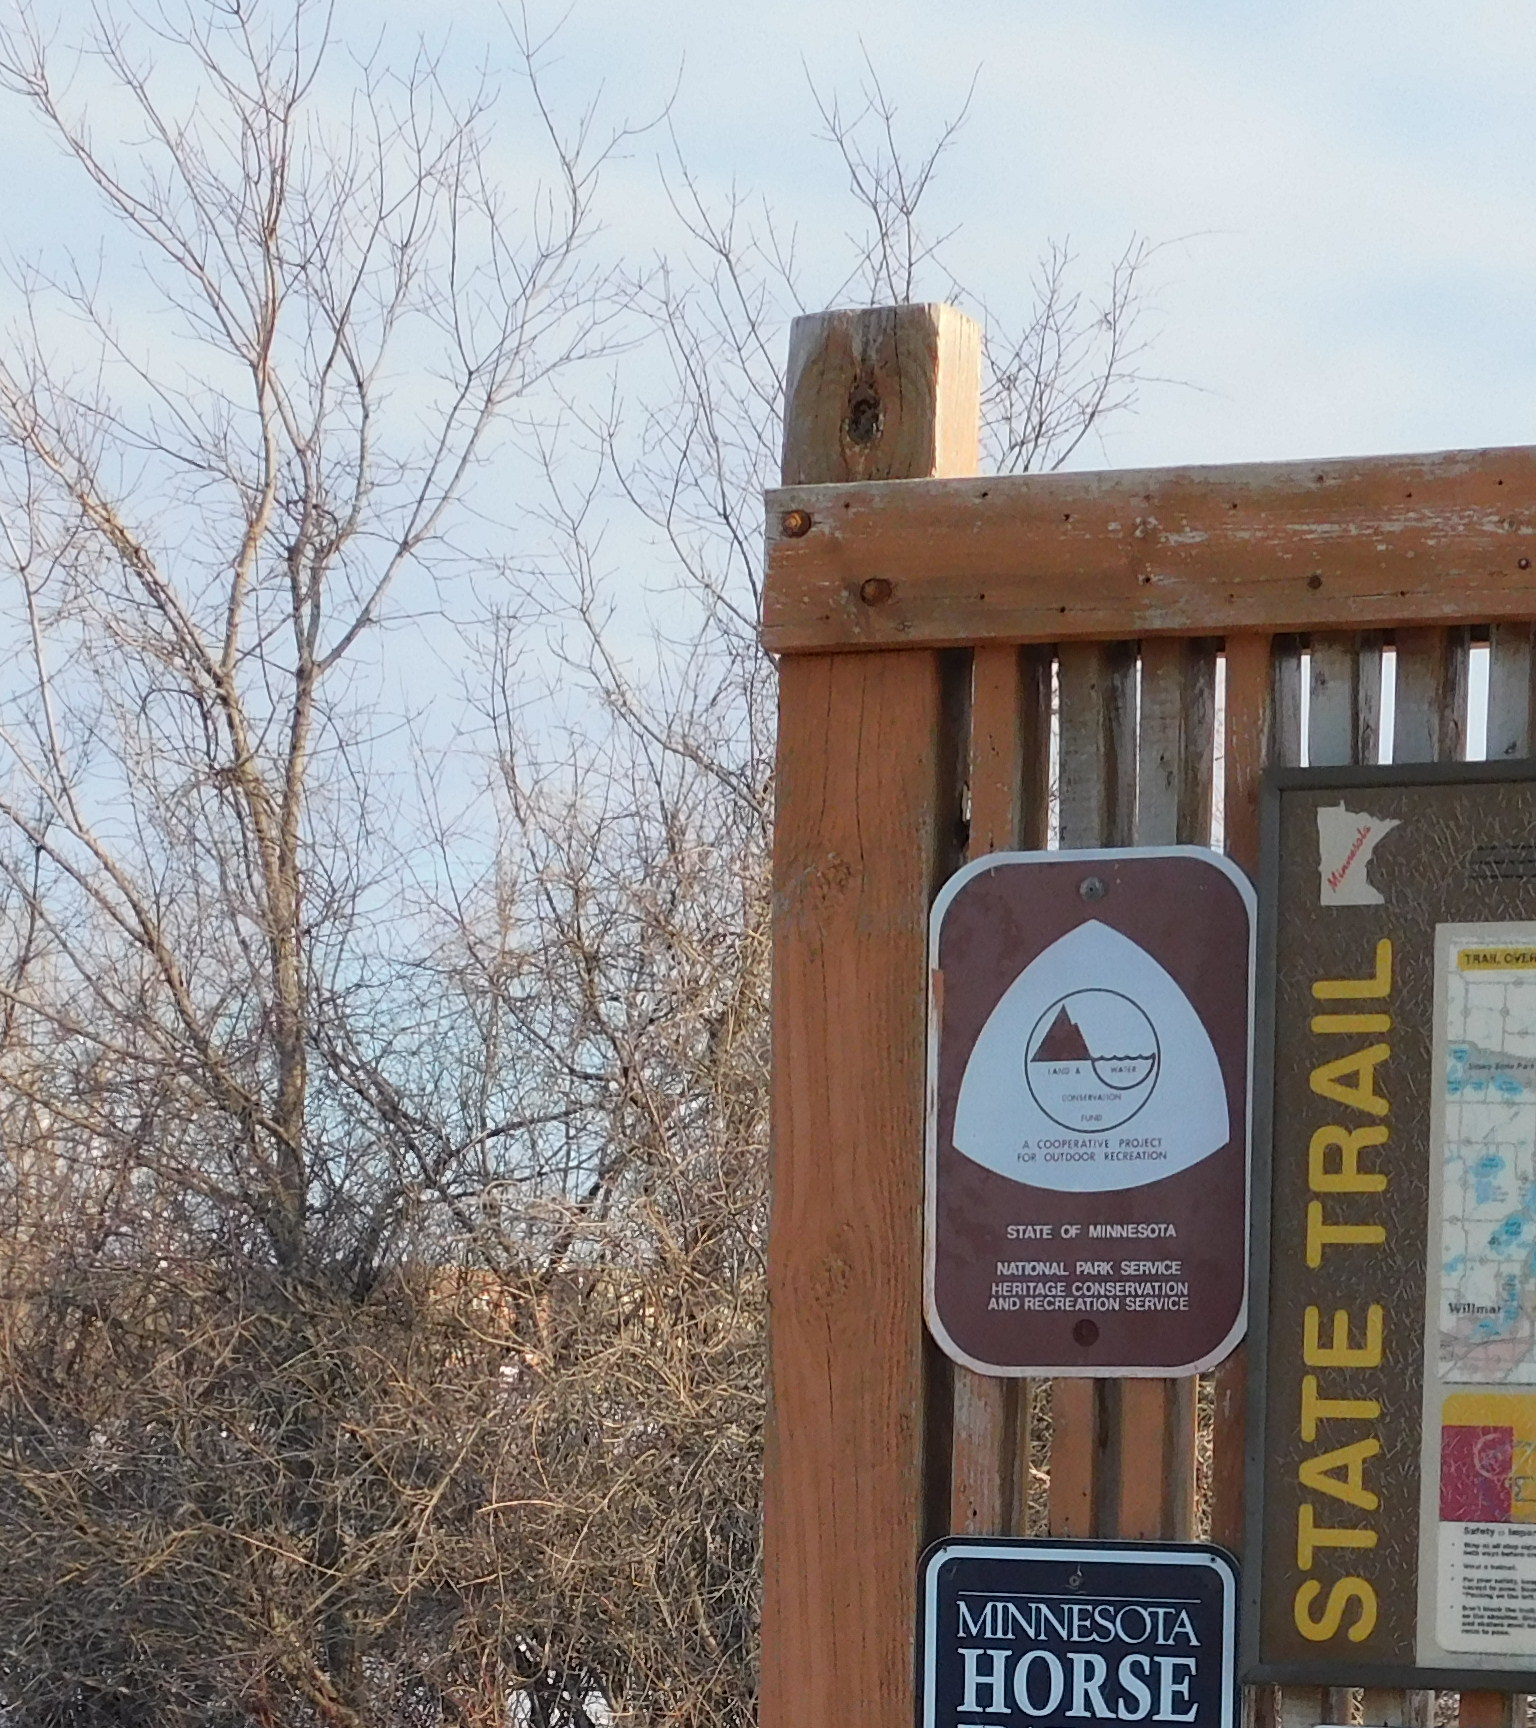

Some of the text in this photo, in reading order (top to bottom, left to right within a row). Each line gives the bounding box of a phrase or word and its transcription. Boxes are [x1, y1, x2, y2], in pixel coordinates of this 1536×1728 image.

[1464, 954, 1500, 964] TRAIL
[1037, 1139, 1109, 1149] COOPERATIVE
[1119, 1138, 1161, 1148] PROJECT
[1017, 1151, 1167, 1162] FOR OUTDOOR RECREATION
[1007, 1224, 1176, 1238] STATE OF MINNESOTA
[997, 1260, 1181, 1275] NATIONAL PARK SERVICE
[992, 1281, 1188, 1295] HERITAGE CONSERVATION
[1294, 938, 1392, 1643] STATE TRAIL
[988, 1297, 1188, 1310] AND RECREATION SERVICE
[957, 1601, 1198, 1645] MINNESOTA
[957, 1648, 1197, 1722] HORSE
